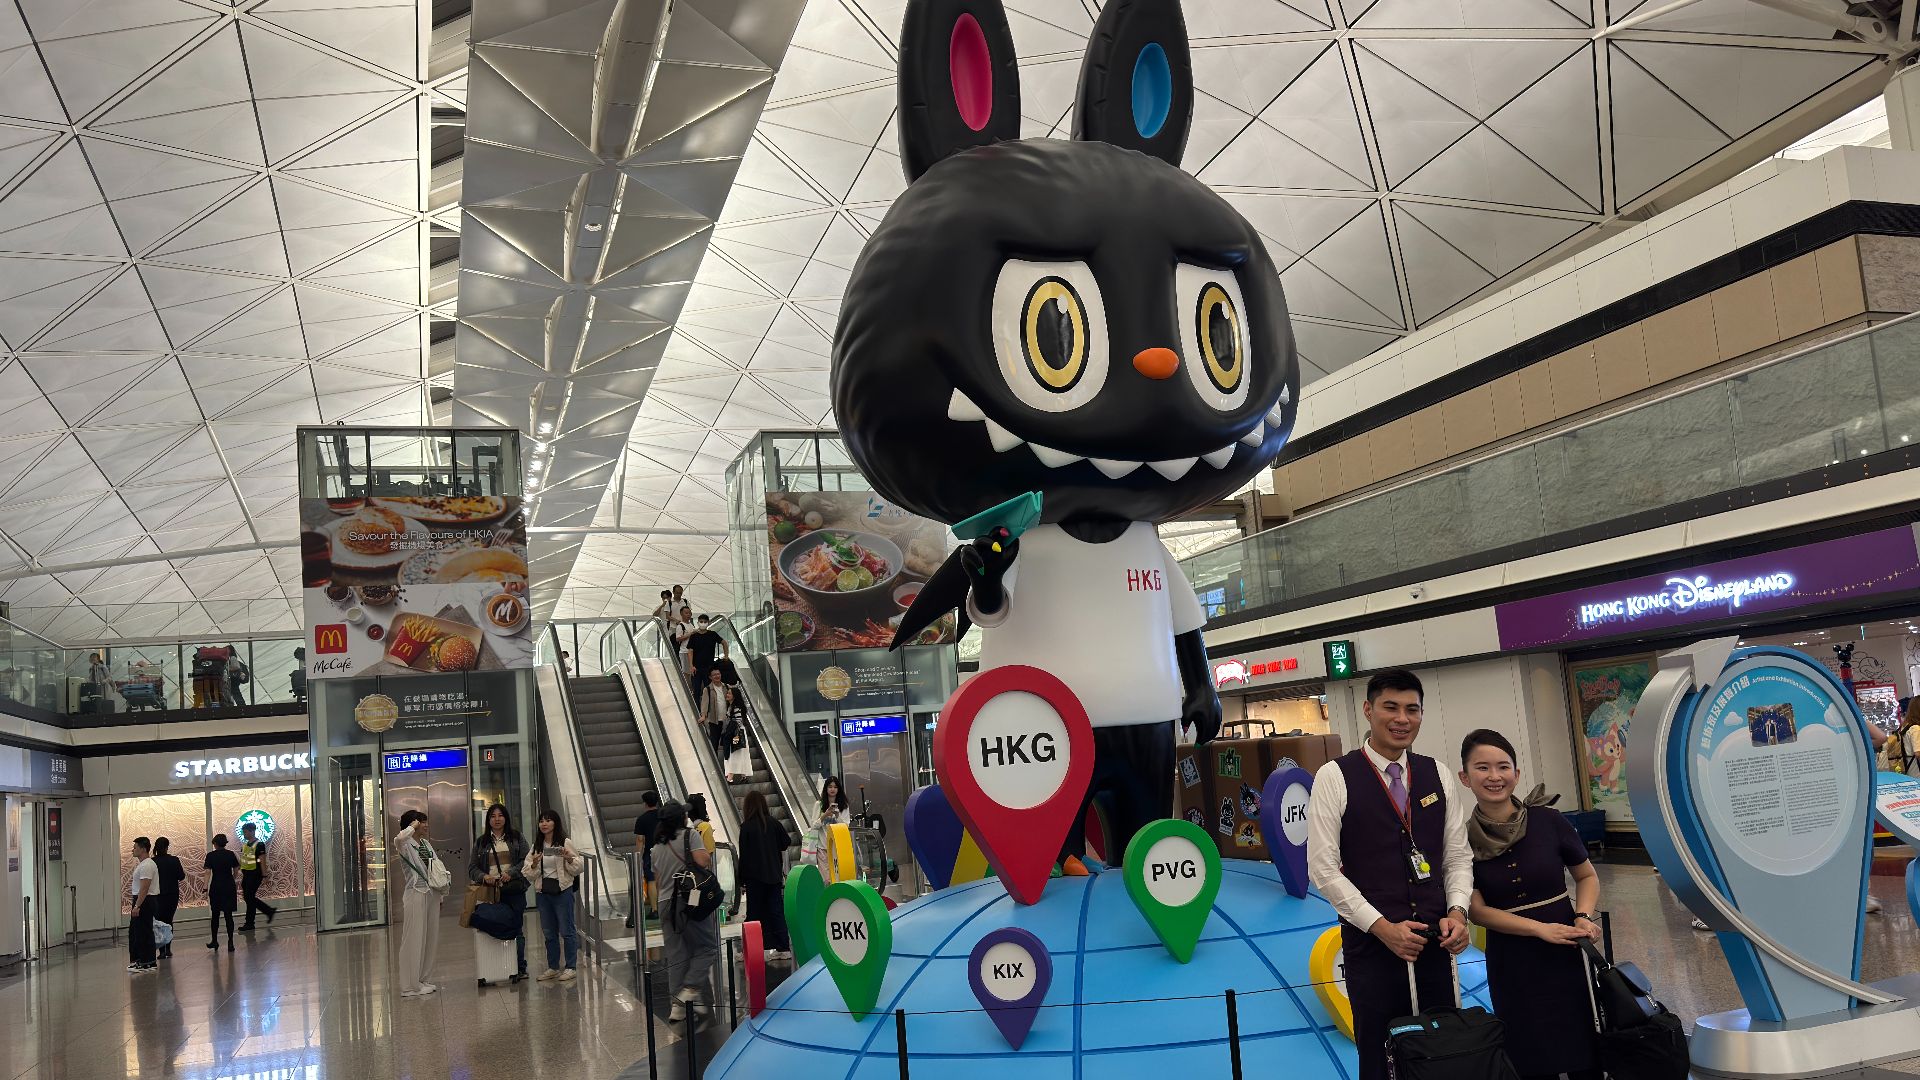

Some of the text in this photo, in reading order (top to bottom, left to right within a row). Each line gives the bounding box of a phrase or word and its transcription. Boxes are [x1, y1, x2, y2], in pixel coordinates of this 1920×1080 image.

[349, 529, 494, 541] Savour the Flavours of HKIA
[1127, 568, 1162, 591] HKG
[1581, 600, 1624, 623] HONG
[1626, 592, 1670, 616] KONG
[313, 657, 352, 674] McCafé
[402, 754, 427, 763] 升降機
[980, 732, 1057, 767] HKG
[175, 752, 310, 778] STARBUCK
[1284, 804, 1307, 824] JFK
[1151, 859, 1197, 882] PVG
[831, 921, 867, 941] BKK
[993, 962, 1025, 979] KIX
